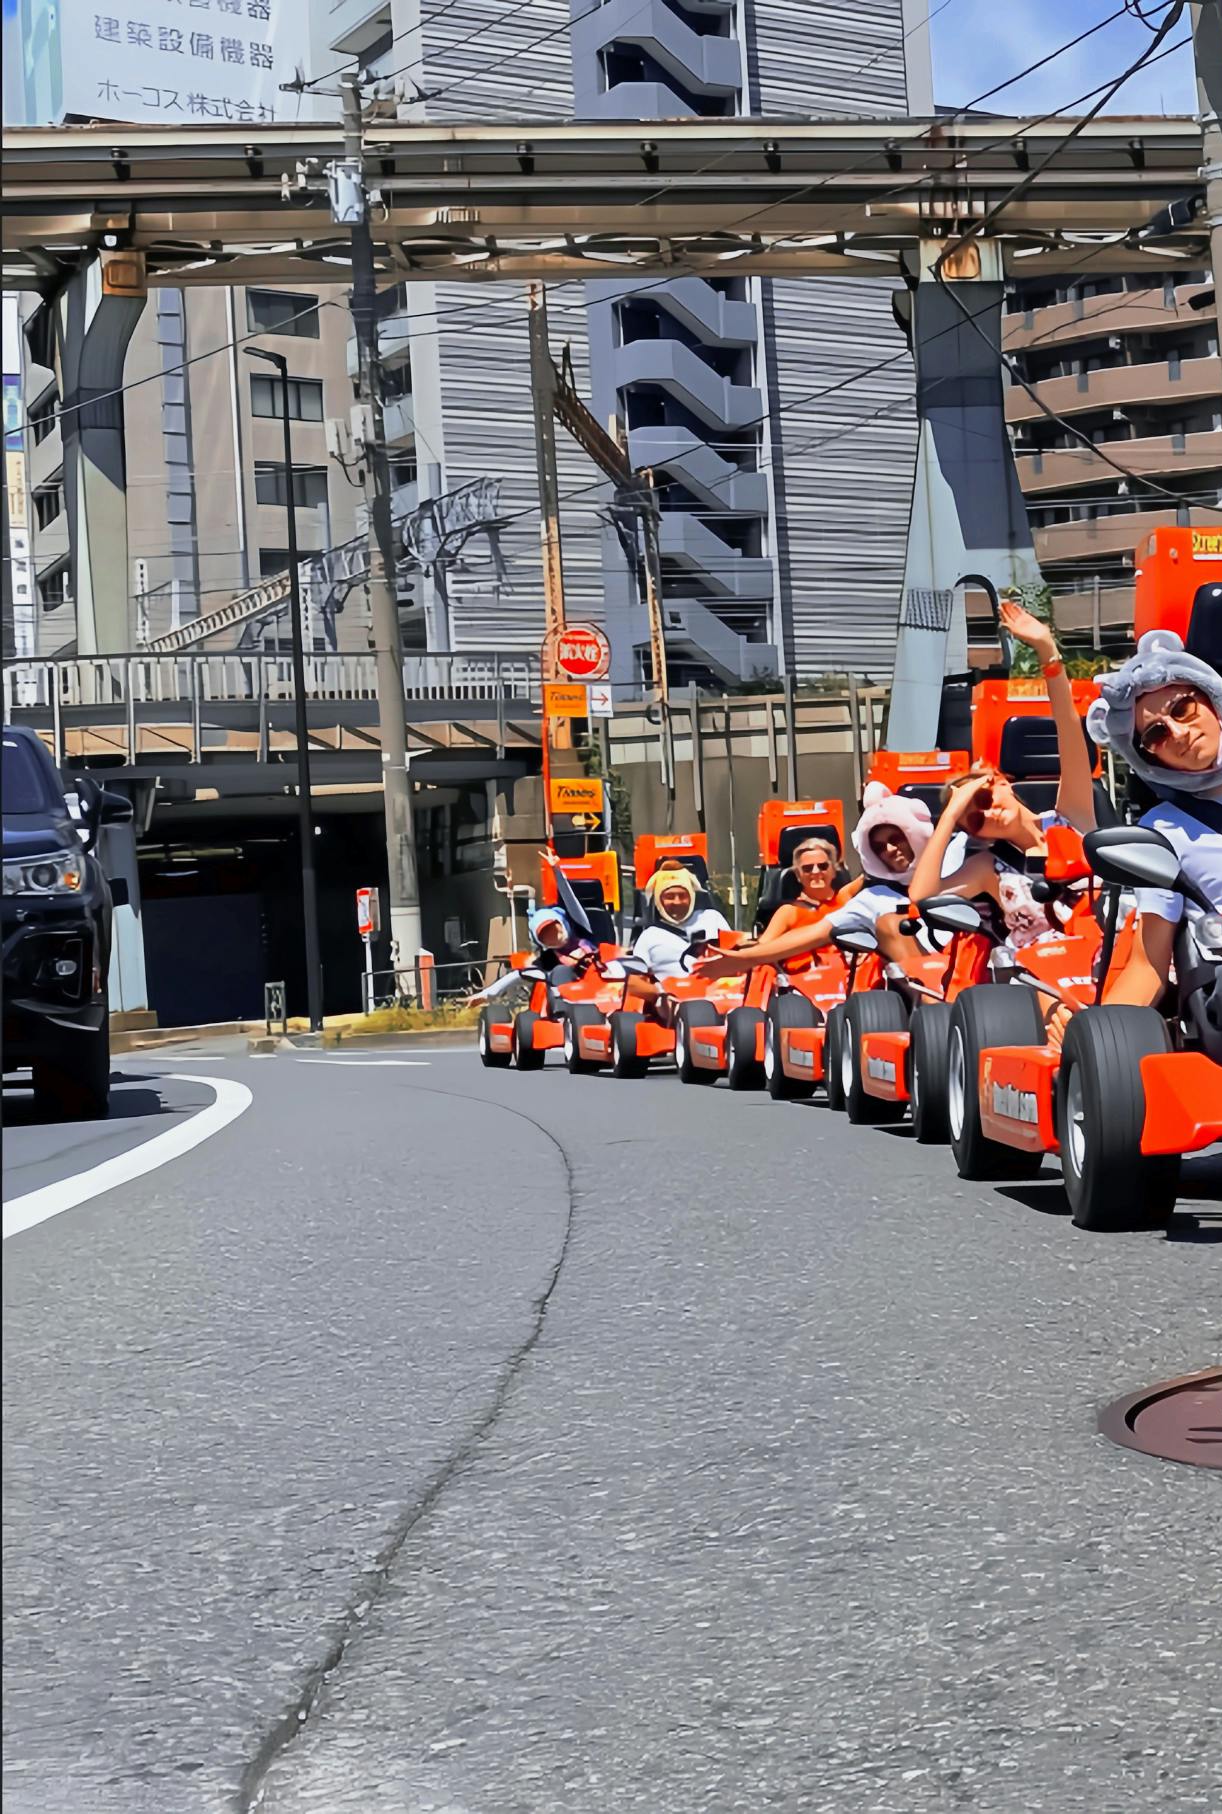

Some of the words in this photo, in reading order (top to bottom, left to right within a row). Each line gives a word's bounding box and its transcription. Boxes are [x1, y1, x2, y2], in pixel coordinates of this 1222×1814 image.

[94, 15, 274, 70] 建築設備機器
[97, 78, 277, 122] ホーコス株式会社
